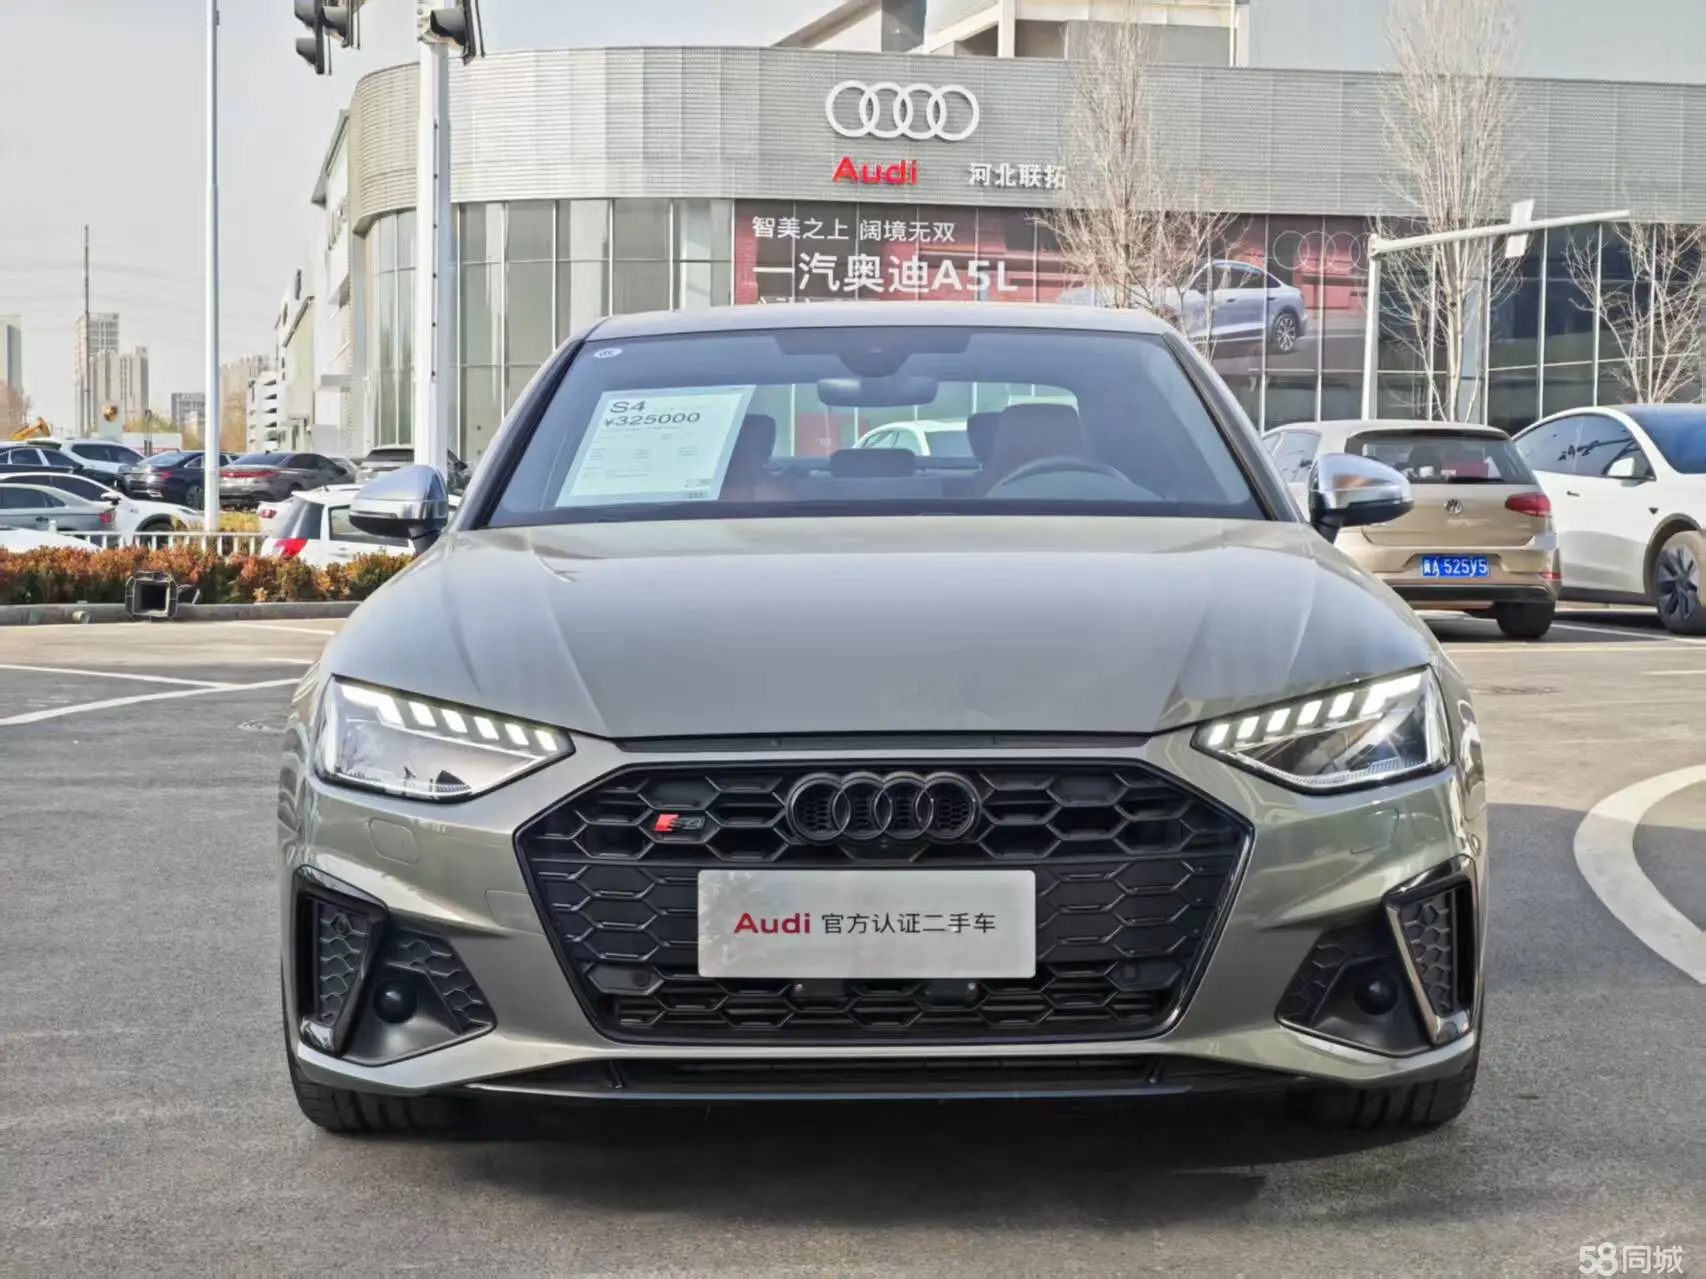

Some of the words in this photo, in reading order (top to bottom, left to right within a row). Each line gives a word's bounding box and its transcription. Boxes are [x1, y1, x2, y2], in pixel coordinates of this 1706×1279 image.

[831, 156, 919, 185] Audi
[752, 216, 849, 239] 智美之上
[859, 219, 956, 243] 阔境无双
[752, 251, 1019, 293] 一汽奥迪A5L
[603, 412, 701, 427] ¥325000
[610, 401, 646, 414] S4
[734, 912, 811, 934] Audi
[821, 912, 996, 934] 官方认证二手车
